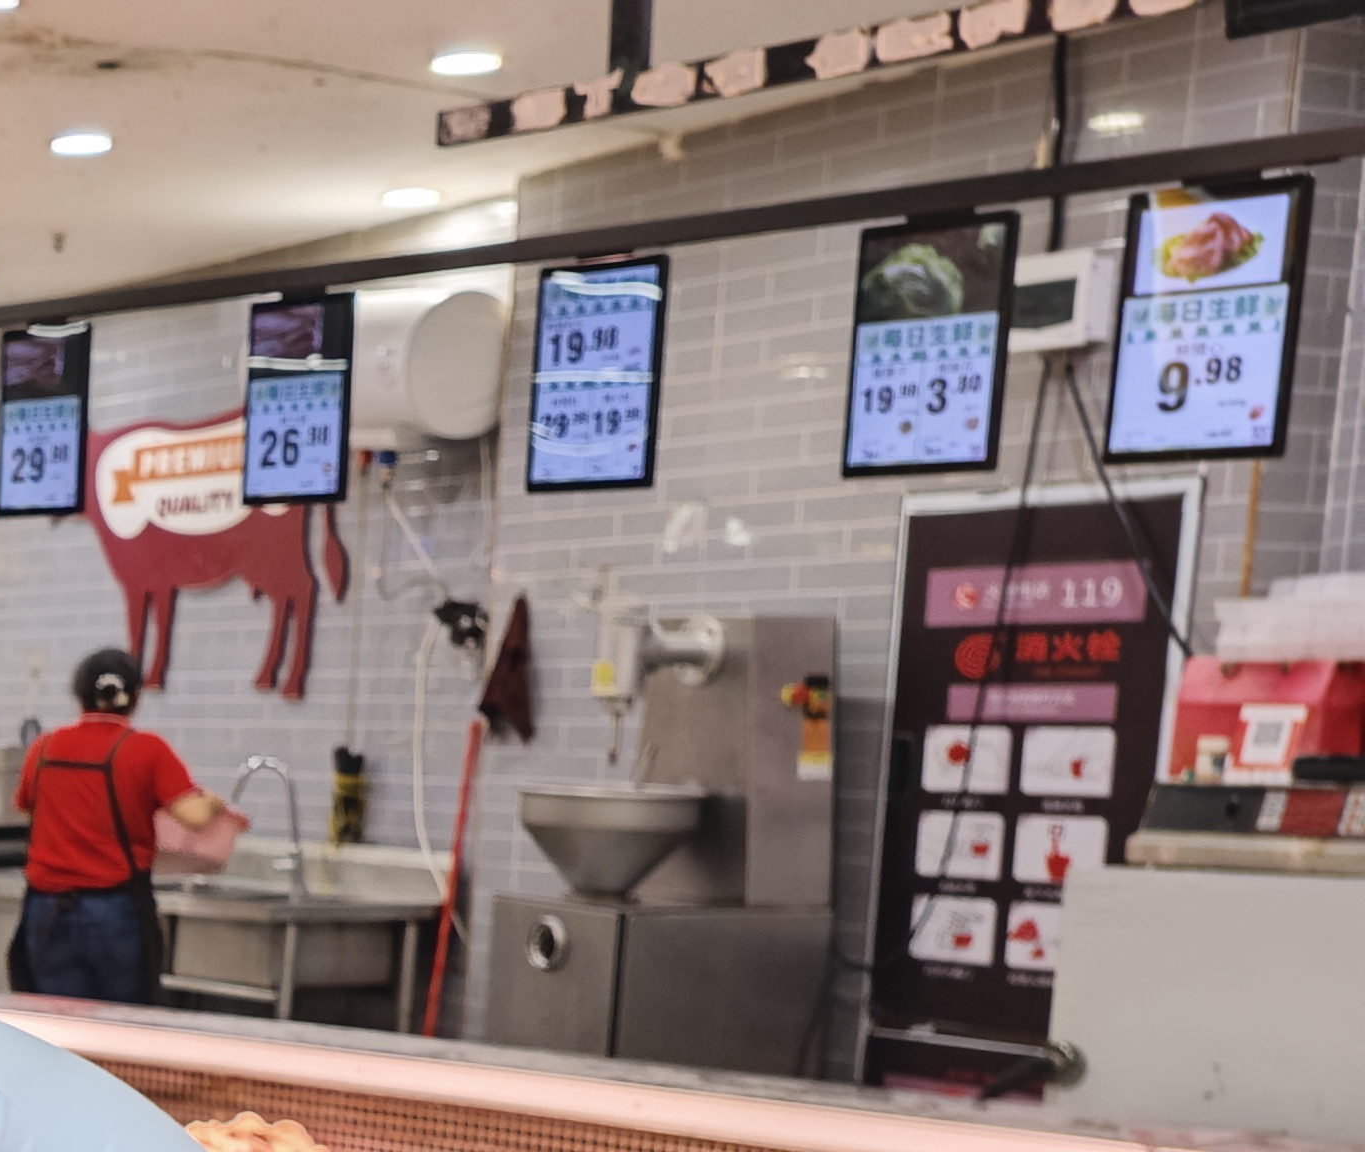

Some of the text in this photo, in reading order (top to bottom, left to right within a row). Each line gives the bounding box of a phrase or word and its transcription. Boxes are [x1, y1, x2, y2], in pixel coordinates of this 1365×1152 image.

[1157, 356, 1243, 413] 9.98
[155, 490, 234, 517] QUALITY
[1060, 576, 1123, 608] 119
